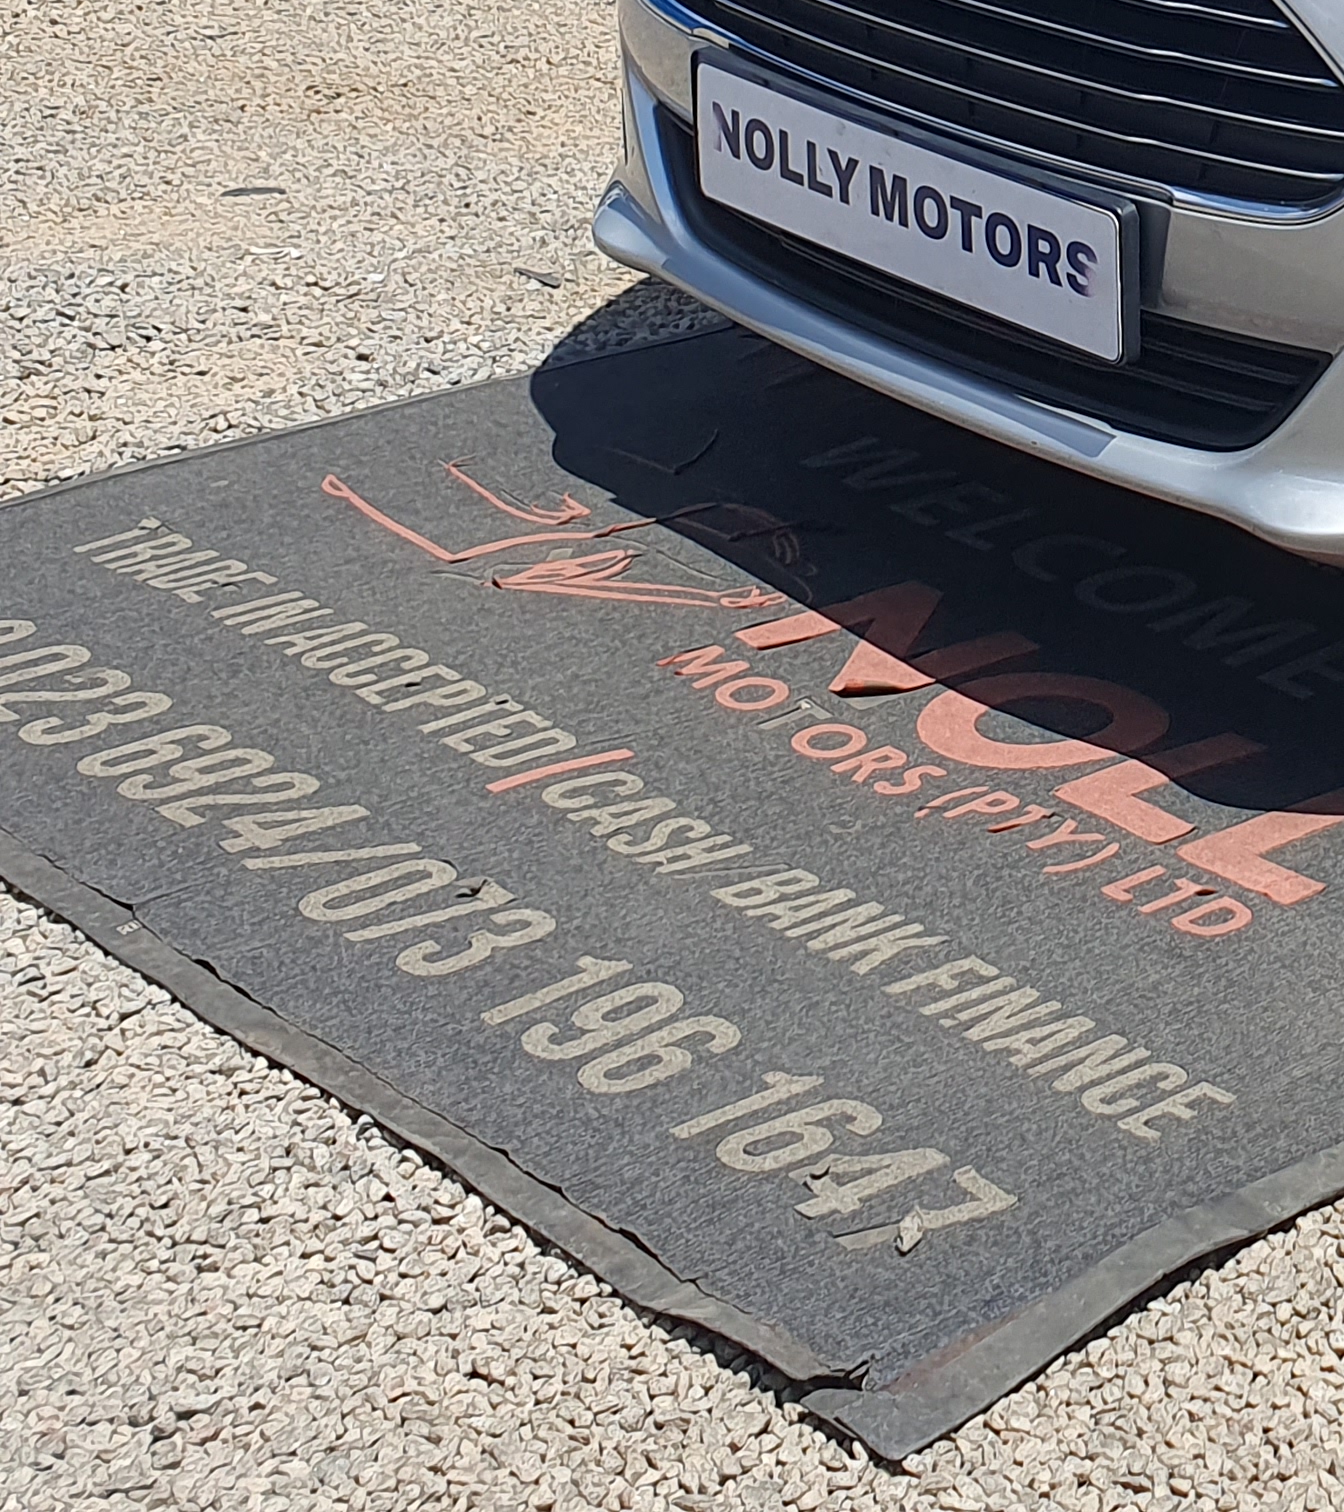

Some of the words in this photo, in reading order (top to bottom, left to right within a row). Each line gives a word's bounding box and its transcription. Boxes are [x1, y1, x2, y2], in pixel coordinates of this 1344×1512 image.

[710, 100, 860, 206] NOLLY
[869, 163, 1099, 299] MOTORS
[73, 516, 279, 604] TRADE
[881, 954, 1237, 1144] FINANCE
[1100, 864, 1254, 937] LTD
[481, 954, 741, 1094] 196
[669, 1070, 1019, 1254] 1647
